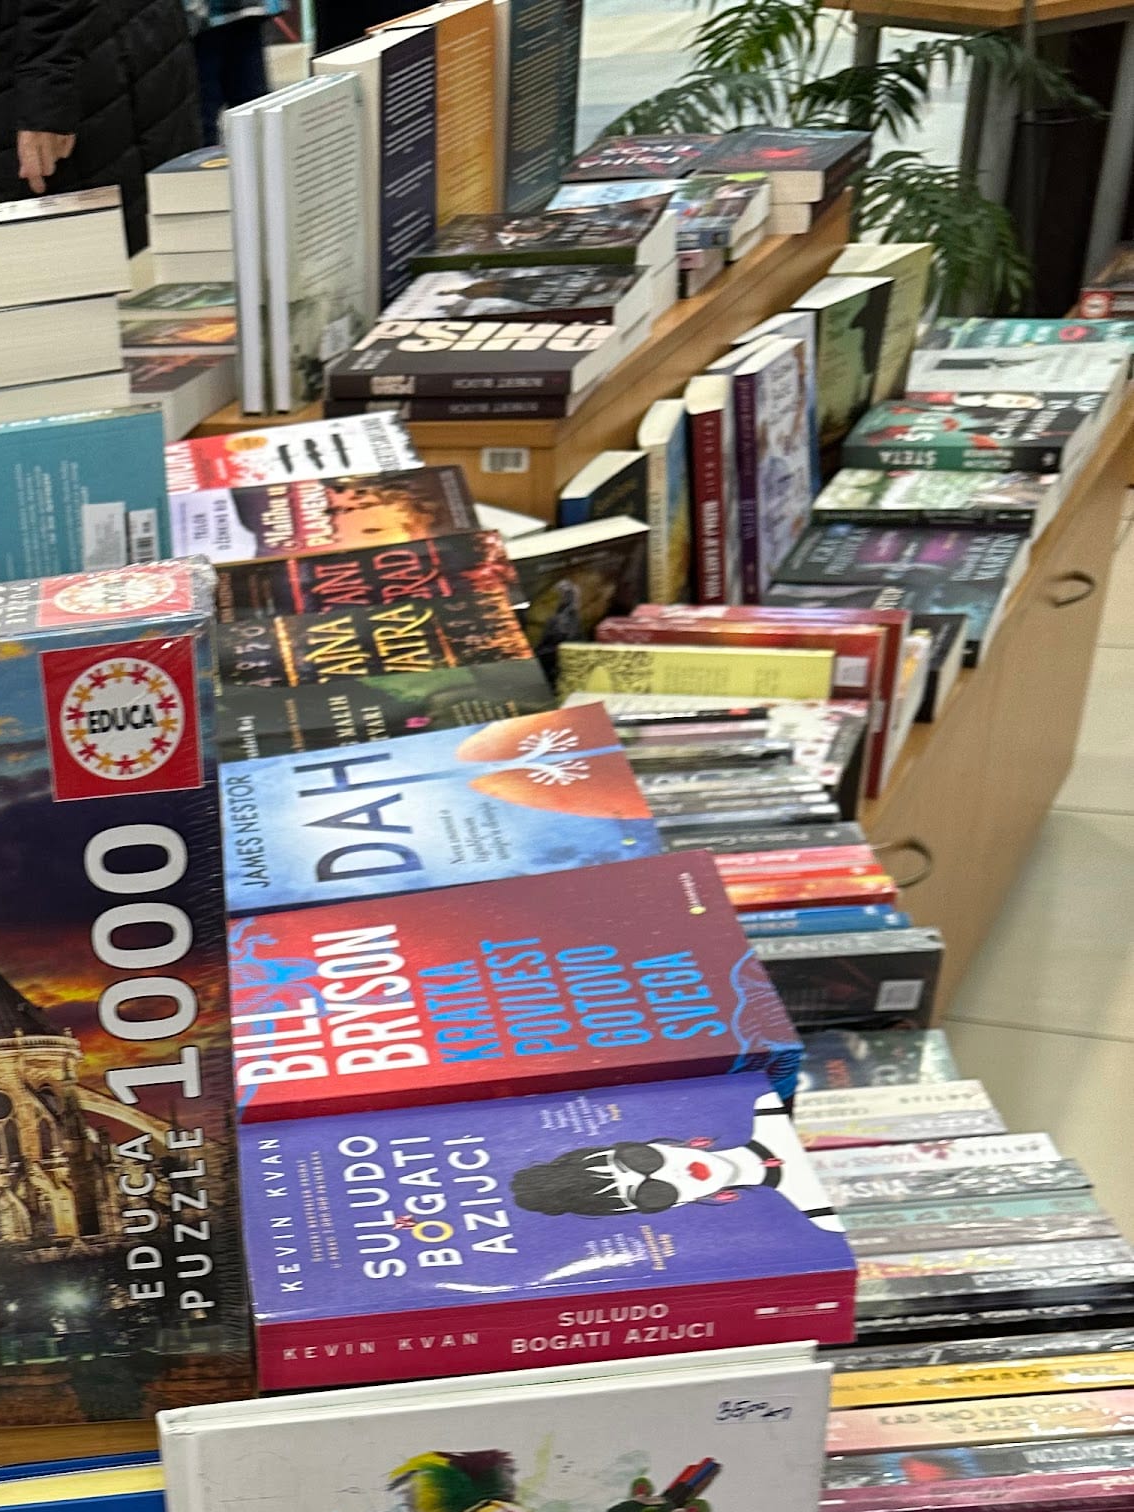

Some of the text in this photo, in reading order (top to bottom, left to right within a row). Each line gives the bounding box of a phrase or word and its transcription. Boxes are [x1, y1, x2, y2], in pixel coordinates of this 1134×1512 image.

[312, 560, 373, 612] AJNI
[372, 548, 439, 604] RAD
[303, 615, 371, 684] AJNA
[85, 702, 157, 738] EDUCA
[227, 774, 269, 888] JAMES NESTOR
[293, 752, 424, 883] DAH
[82, 822, 205, 1107] 1000
[312, 925, 429, 1075] BRYSON
[418, 960, 505, 1064] KRATKA
[481, 937, 578, 1057] POVIJEST
[555, 944, 655, 1048] GOTOVO
[633, 951, 728, 1040] SVEGA
[231, 996, 328, 1086] BILL
[110, 1133, 163, 1303] EDUCA
[165, 1122, 215, 1313] PUZZLE
[258, 1138, 304, 1293] KEVIN KVAN
[338, 1135, 408, 1279] SULUDO
[389, 1136, 464, 1268] BOGATI
[443, 1134, 518, 1256] AZIJCI
[283, 1331, 478, 1360] KEVIN KVAN
[511, 1321, 715, 1355] BOGATI AZIJCI
[558, 1302, 669, 1328] SULUDO
